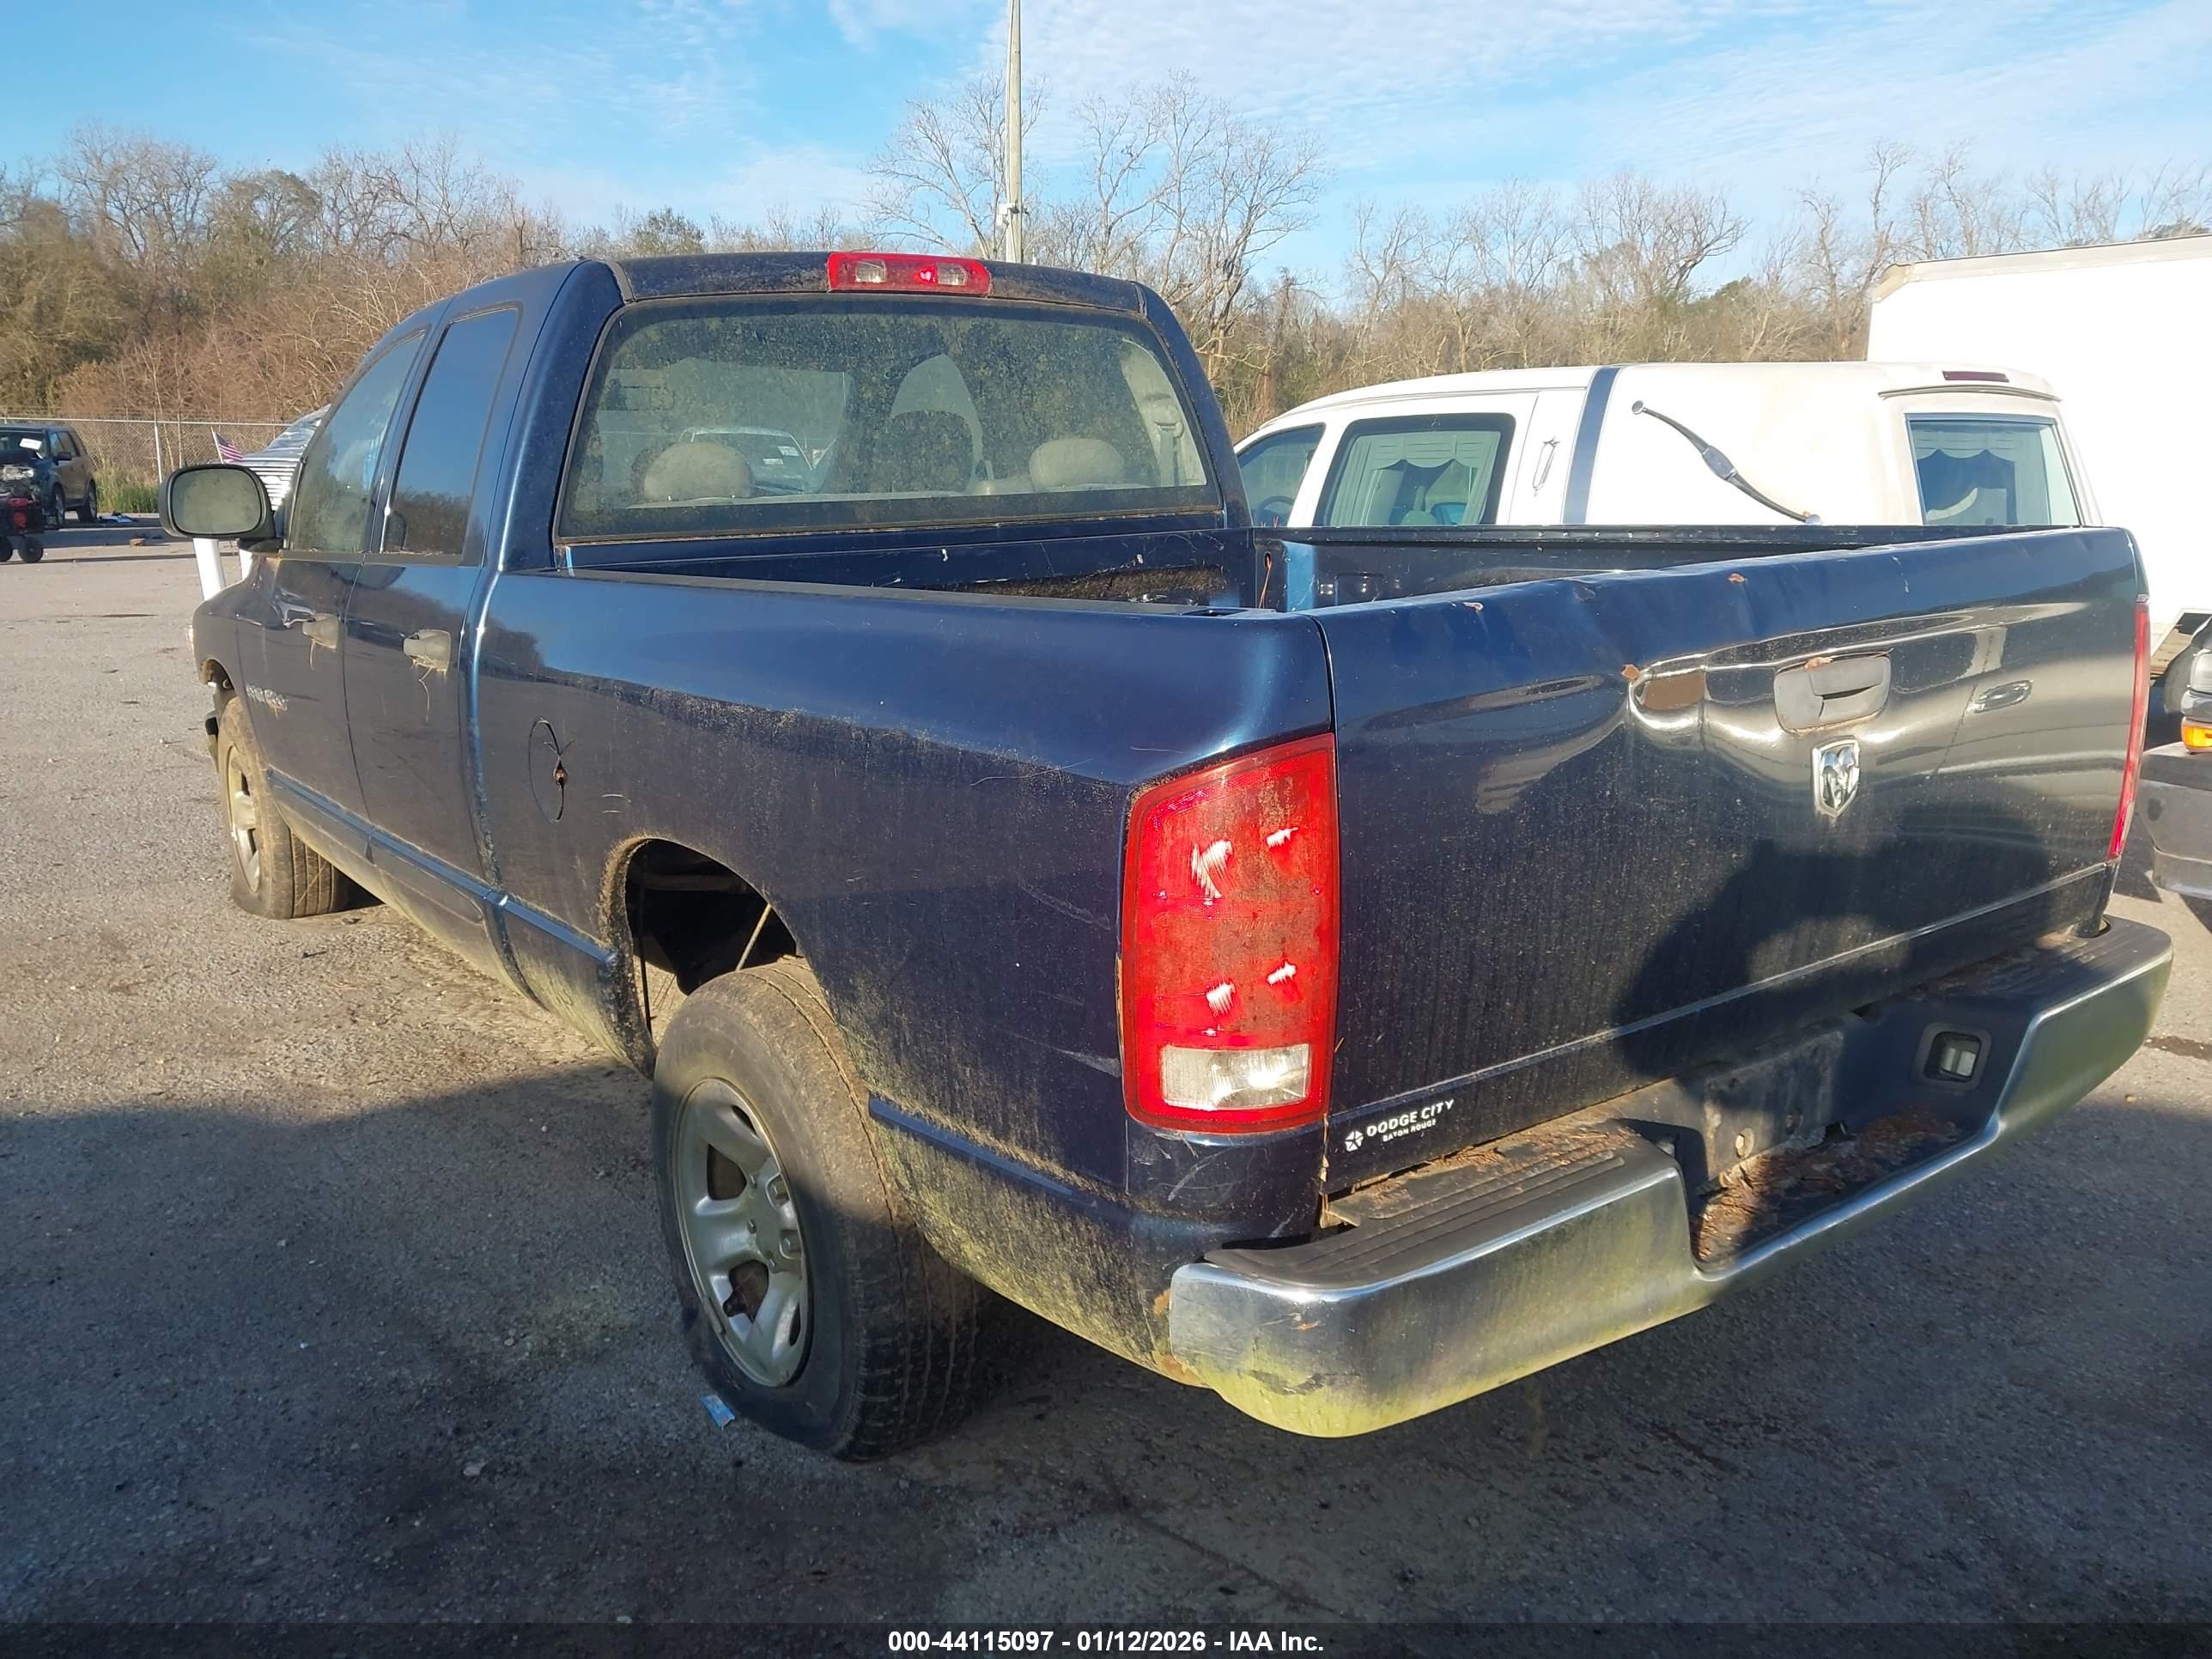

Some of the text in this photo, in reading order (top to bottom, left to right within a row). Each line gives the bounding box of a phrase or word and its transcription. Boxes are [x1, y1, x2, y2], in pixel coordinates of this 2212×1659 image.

[1366, 1098, 1455, 1137] DODGE CITY
[1382, 1119, 1437, 1142] BATON ROUGE
